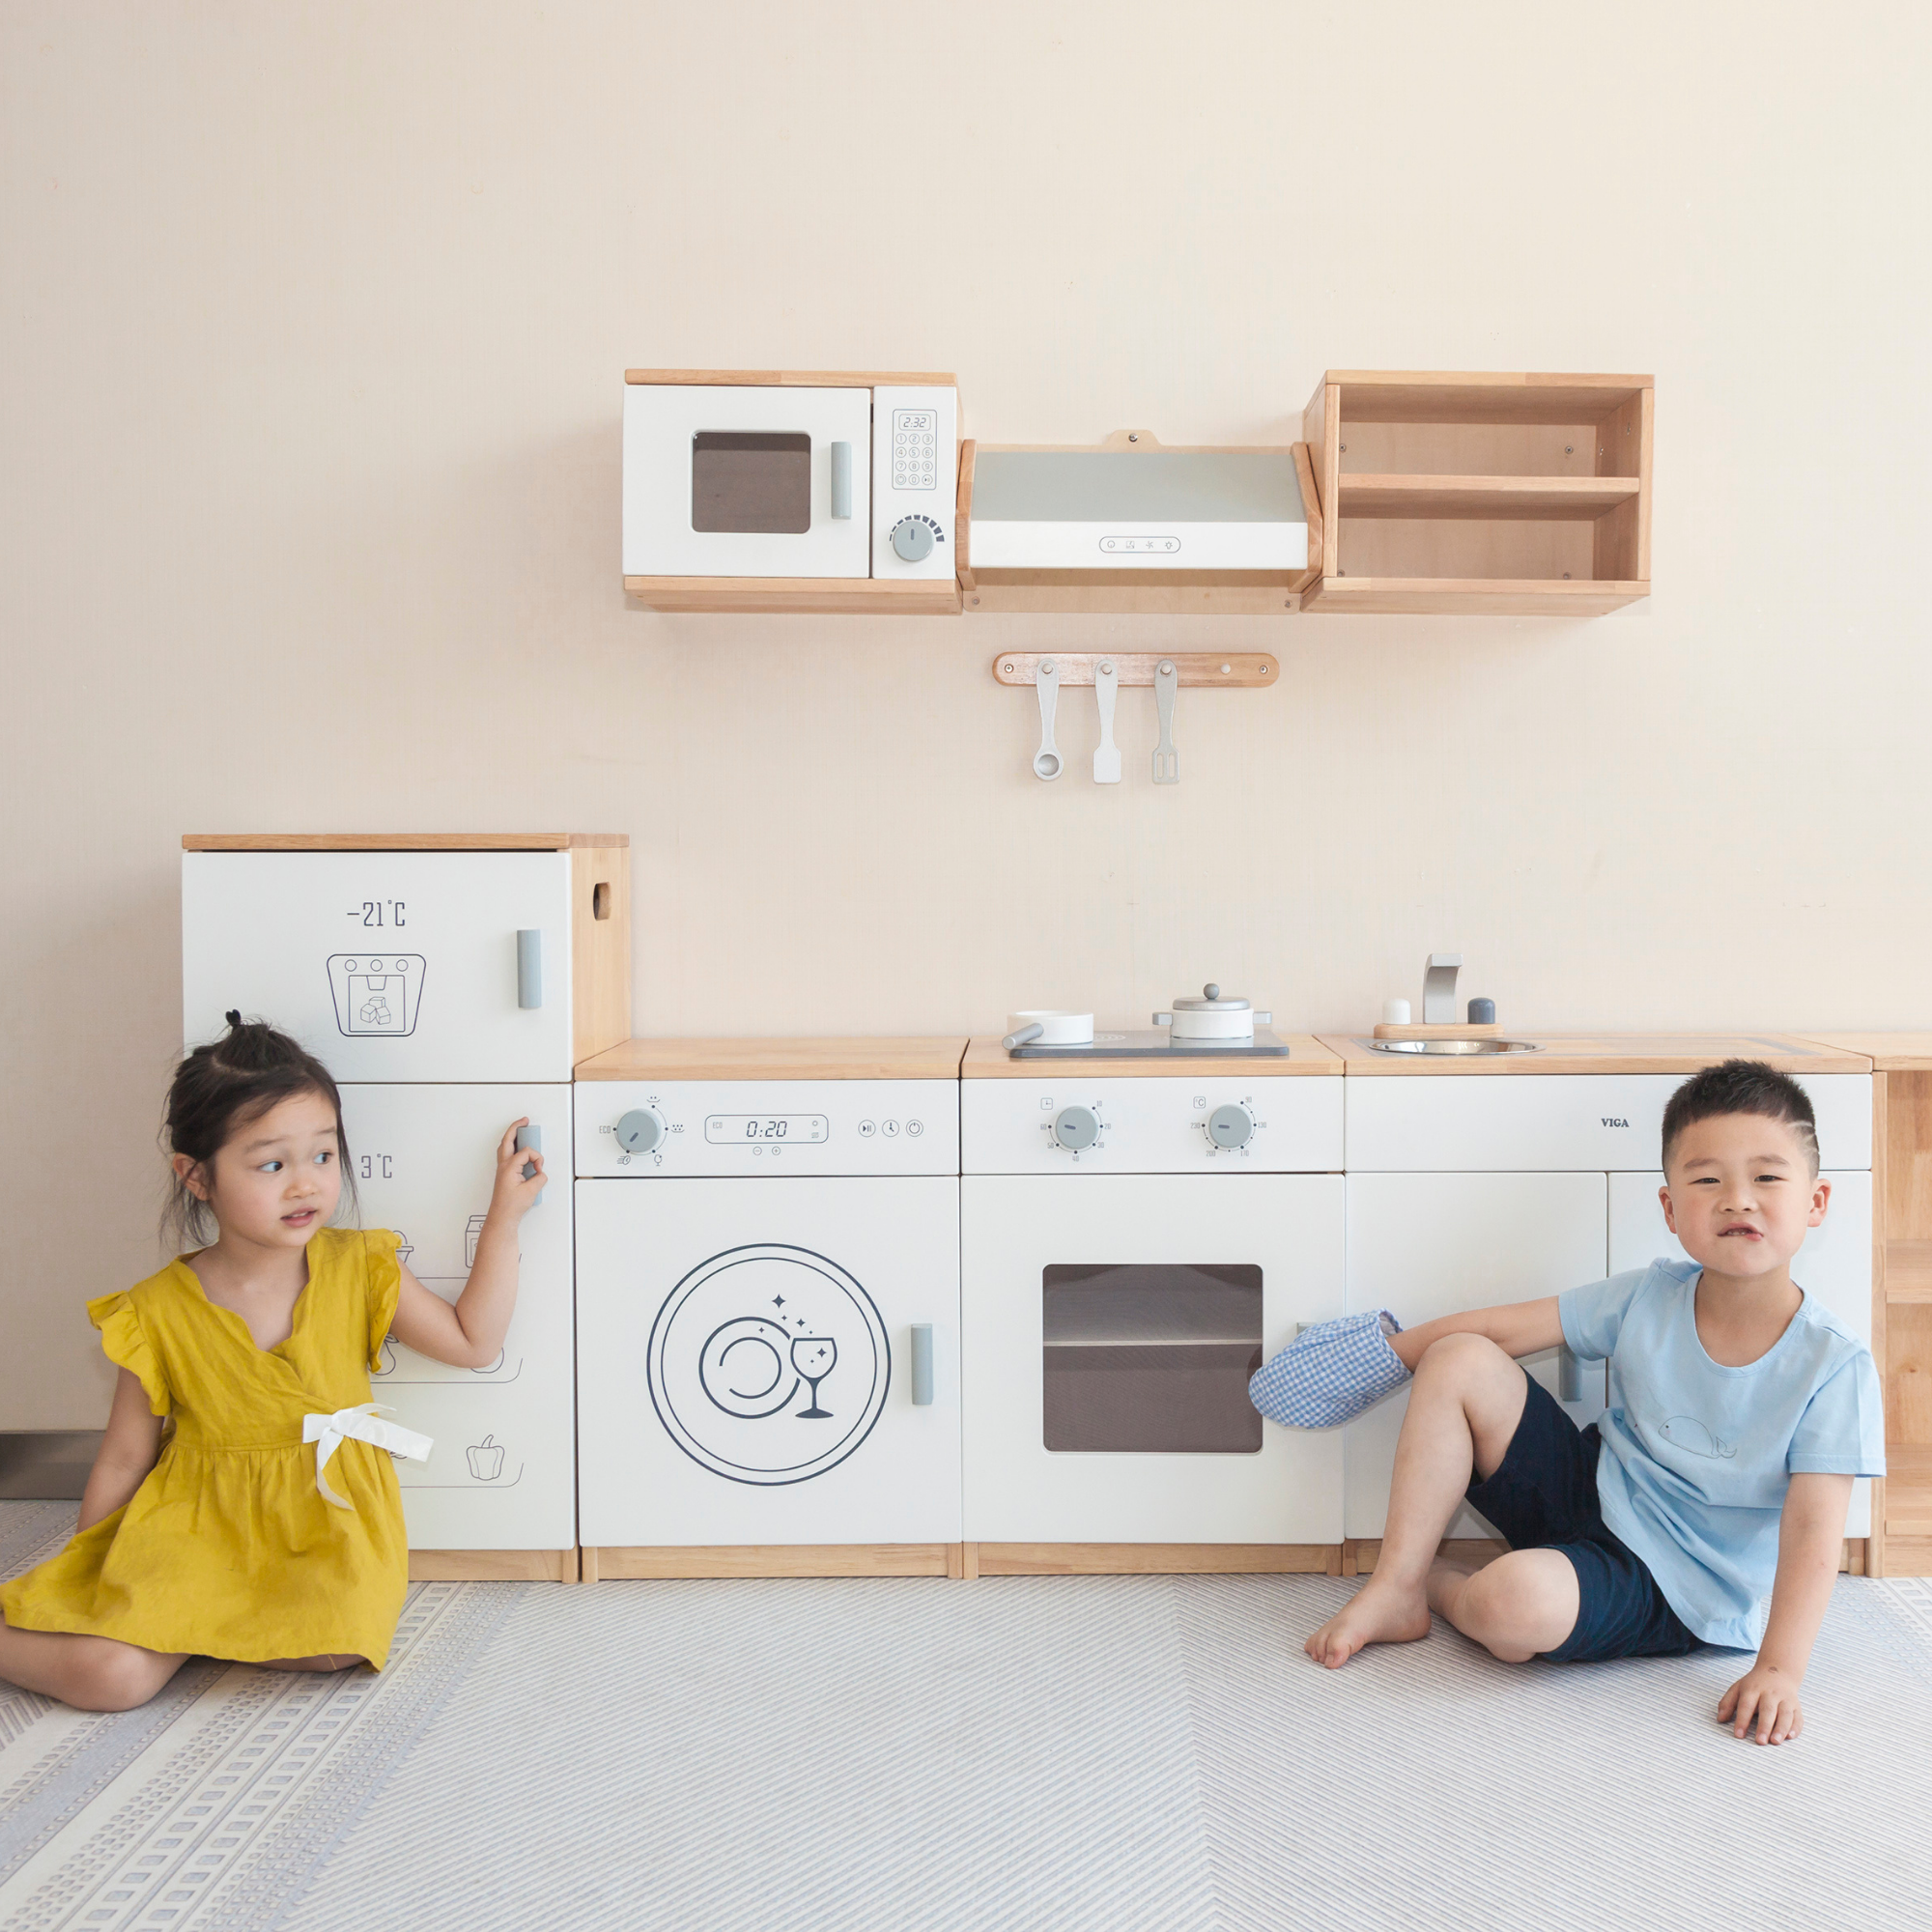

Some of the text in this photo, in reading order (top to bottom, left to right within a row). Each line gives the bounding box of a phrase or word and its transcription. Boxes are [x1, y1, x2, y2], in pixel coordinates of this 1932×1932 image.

[903, 416, 927, 428] 2:32
[1601, 1118, 1630, 1127] VIGA
[599, 1125, 611, 1134] ECO
[746, 1121, 787, 1138] 0:20
